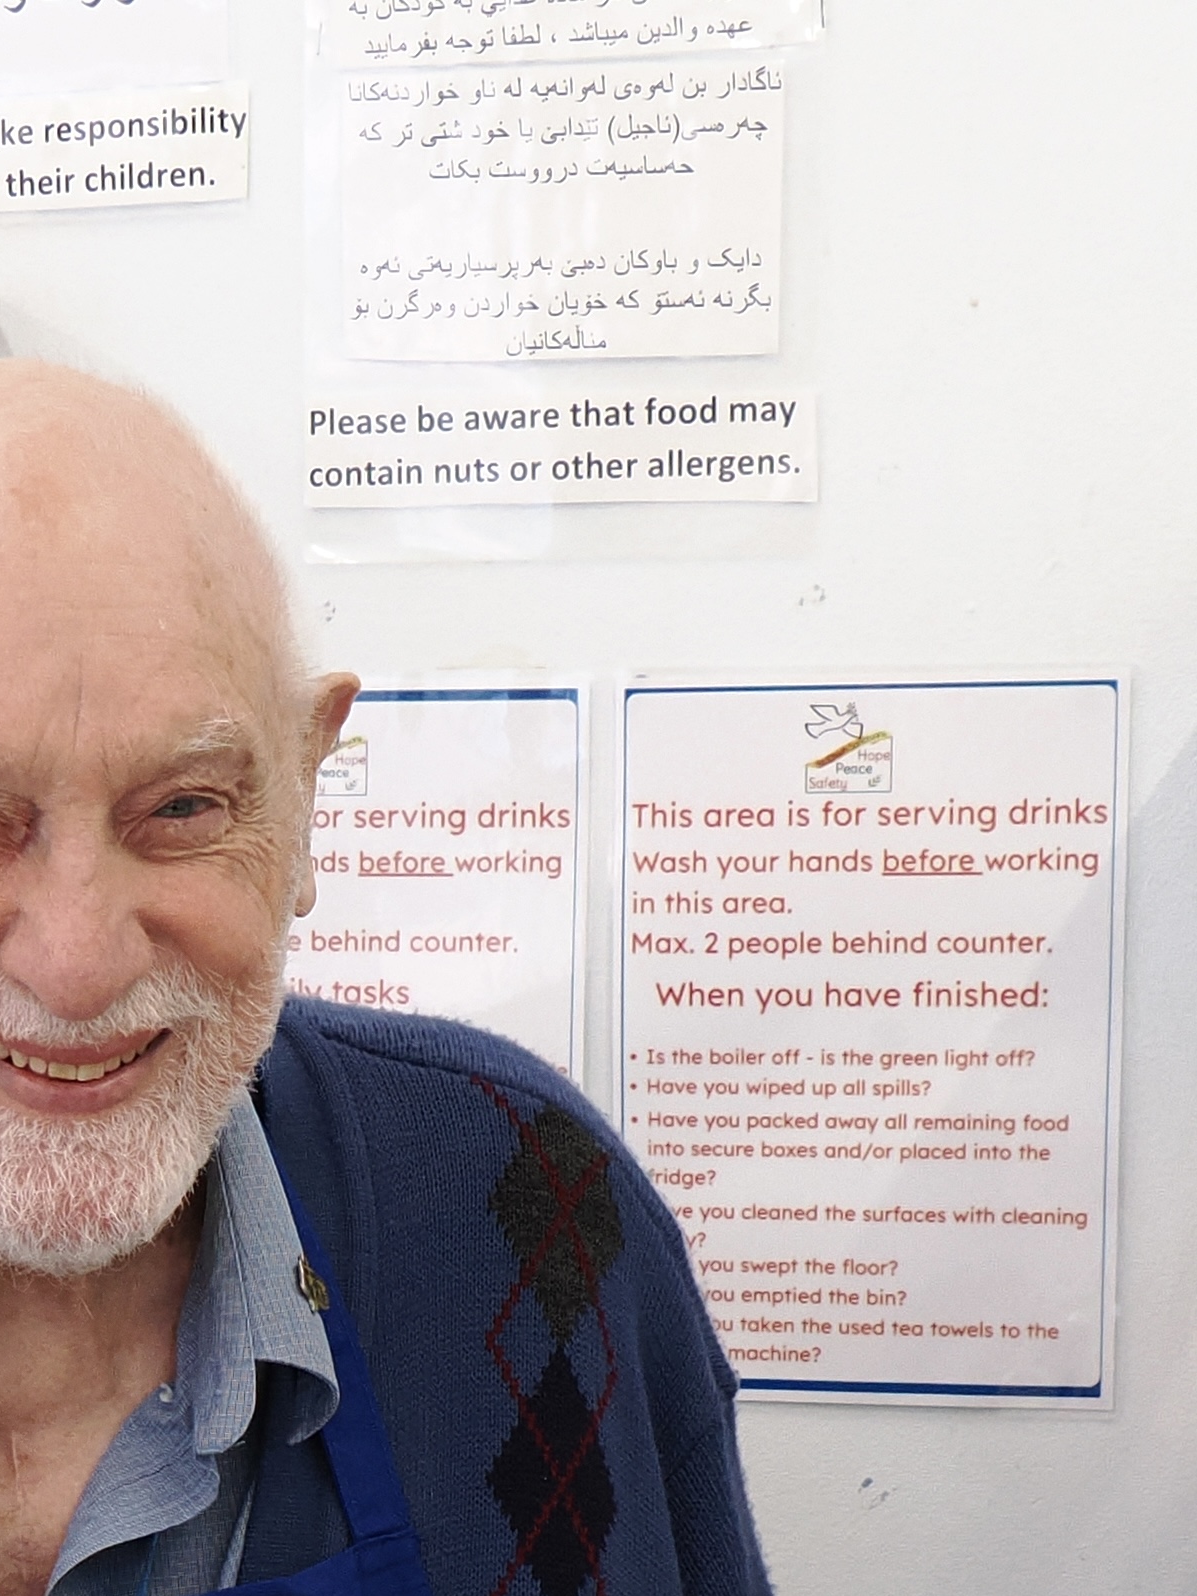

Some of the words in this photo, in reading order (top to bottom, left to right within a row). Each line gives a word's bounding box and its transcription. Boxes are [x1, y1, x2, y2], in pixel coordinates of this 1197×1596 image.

[45, 106, 246, 147] responsibility
[6, 167, 74, 197] their
[86, 162, 214, 192] children.
[311, 408, 406, 435] Please
[418, 405, 453, 432] be
[465, 408, 559, 431] aware
[570, 399, 634, 427] that
[645, 395, 716, 425] food
[730, 401, 796, 428] may
[310, 458, 422, 487] contain
[435, 458, 499, 483] nuts
[511, 461, 541, 481] or
[552, 451, 637, 480] other
[648, 449, 799, 482] allergens.
[836, 762, 873, 775] Peace
[858, 750, 891, 763] Hope
[809, 777, 848, 790] Safety
[314, 810, 344, 830] or
[354, 801, 465, 836] serving
[478, 801, 570, 829] drinks
[632, 801, 692, 828] This
[704, 808, 774, 828] area
[788, 800, 809, 827] is
[822, 801, 866, 827] for
[878, 798, 996, 833] serving
[1009, 797, 1107, 824] drinks
[358, 850, 448, 877] before
[455, 850, 563, 879] working
[633, 850, 707, 873] Wash
[716, 855, 780, 879] your
[789, 849, 873, 873] hands
[882, 849, 976, 876] before
[985, 847, 1100, 877] working
[633, 891, 654, 914] in
[665, 891, 712, 915] this
[723, 896, 792, 914] area.
[312, 929, 400, 952] behind
[410, 932, 517, 952] counter.
[632, 933, 694, 954] Max.
[705, 932, 718, 954] 2
[729, 931, 822, 960] people
[833, 930, 926, 954] behind
[937, 932, 1052, 954] counter.
[332, 979, 410, 1005] tasks
[656, 981, 743, 1007] When
[756, 988, 812, 1015] you
[826, 981, 900, 1007] have
[913, 980, 1047, 1008] finished:
[647, 1048, 665, 1065] Is
[672, 1048, 702, 1065] the
[710, 1047, 765, 1065] boiler
[772, 1048, 800, 1065] off
[821, 1049, 835, 1066] is
[842, 1049, 873, 1066] the
[880, 1053, 937, 1071] green
[945, 1049, 989, 1071] light
[996, 1049, 1035, 1067] off?
[648, 1078, 697, 1095] Have
[704, 1082, 739, 1099] you
[746, 1078, 805, 1099] wiped
[812, 1083, 836, 1099] up
[843, 1079, 865, 1096] all
[873, 1078, 931, 1099] spills?
[648, 1112, 698, 1128] Have
[705, 1115, 739, 1132] you
[747, 1112, 818, 1133] packed
[825, 1116, 878, 1134] away
[885, 1113, 907, 1130] all
[915, 1113, 1015, 1136] remaining
[1024, 1114, 1069, 1132] food
[699, 1260, 734, 1276] you
[741, 1259, 798, 1278] swept
[805, 1258, 835, 1275] the
[843, 1258, 898, 1276] floor?
[730, 1345, 821, 1363] machine?
